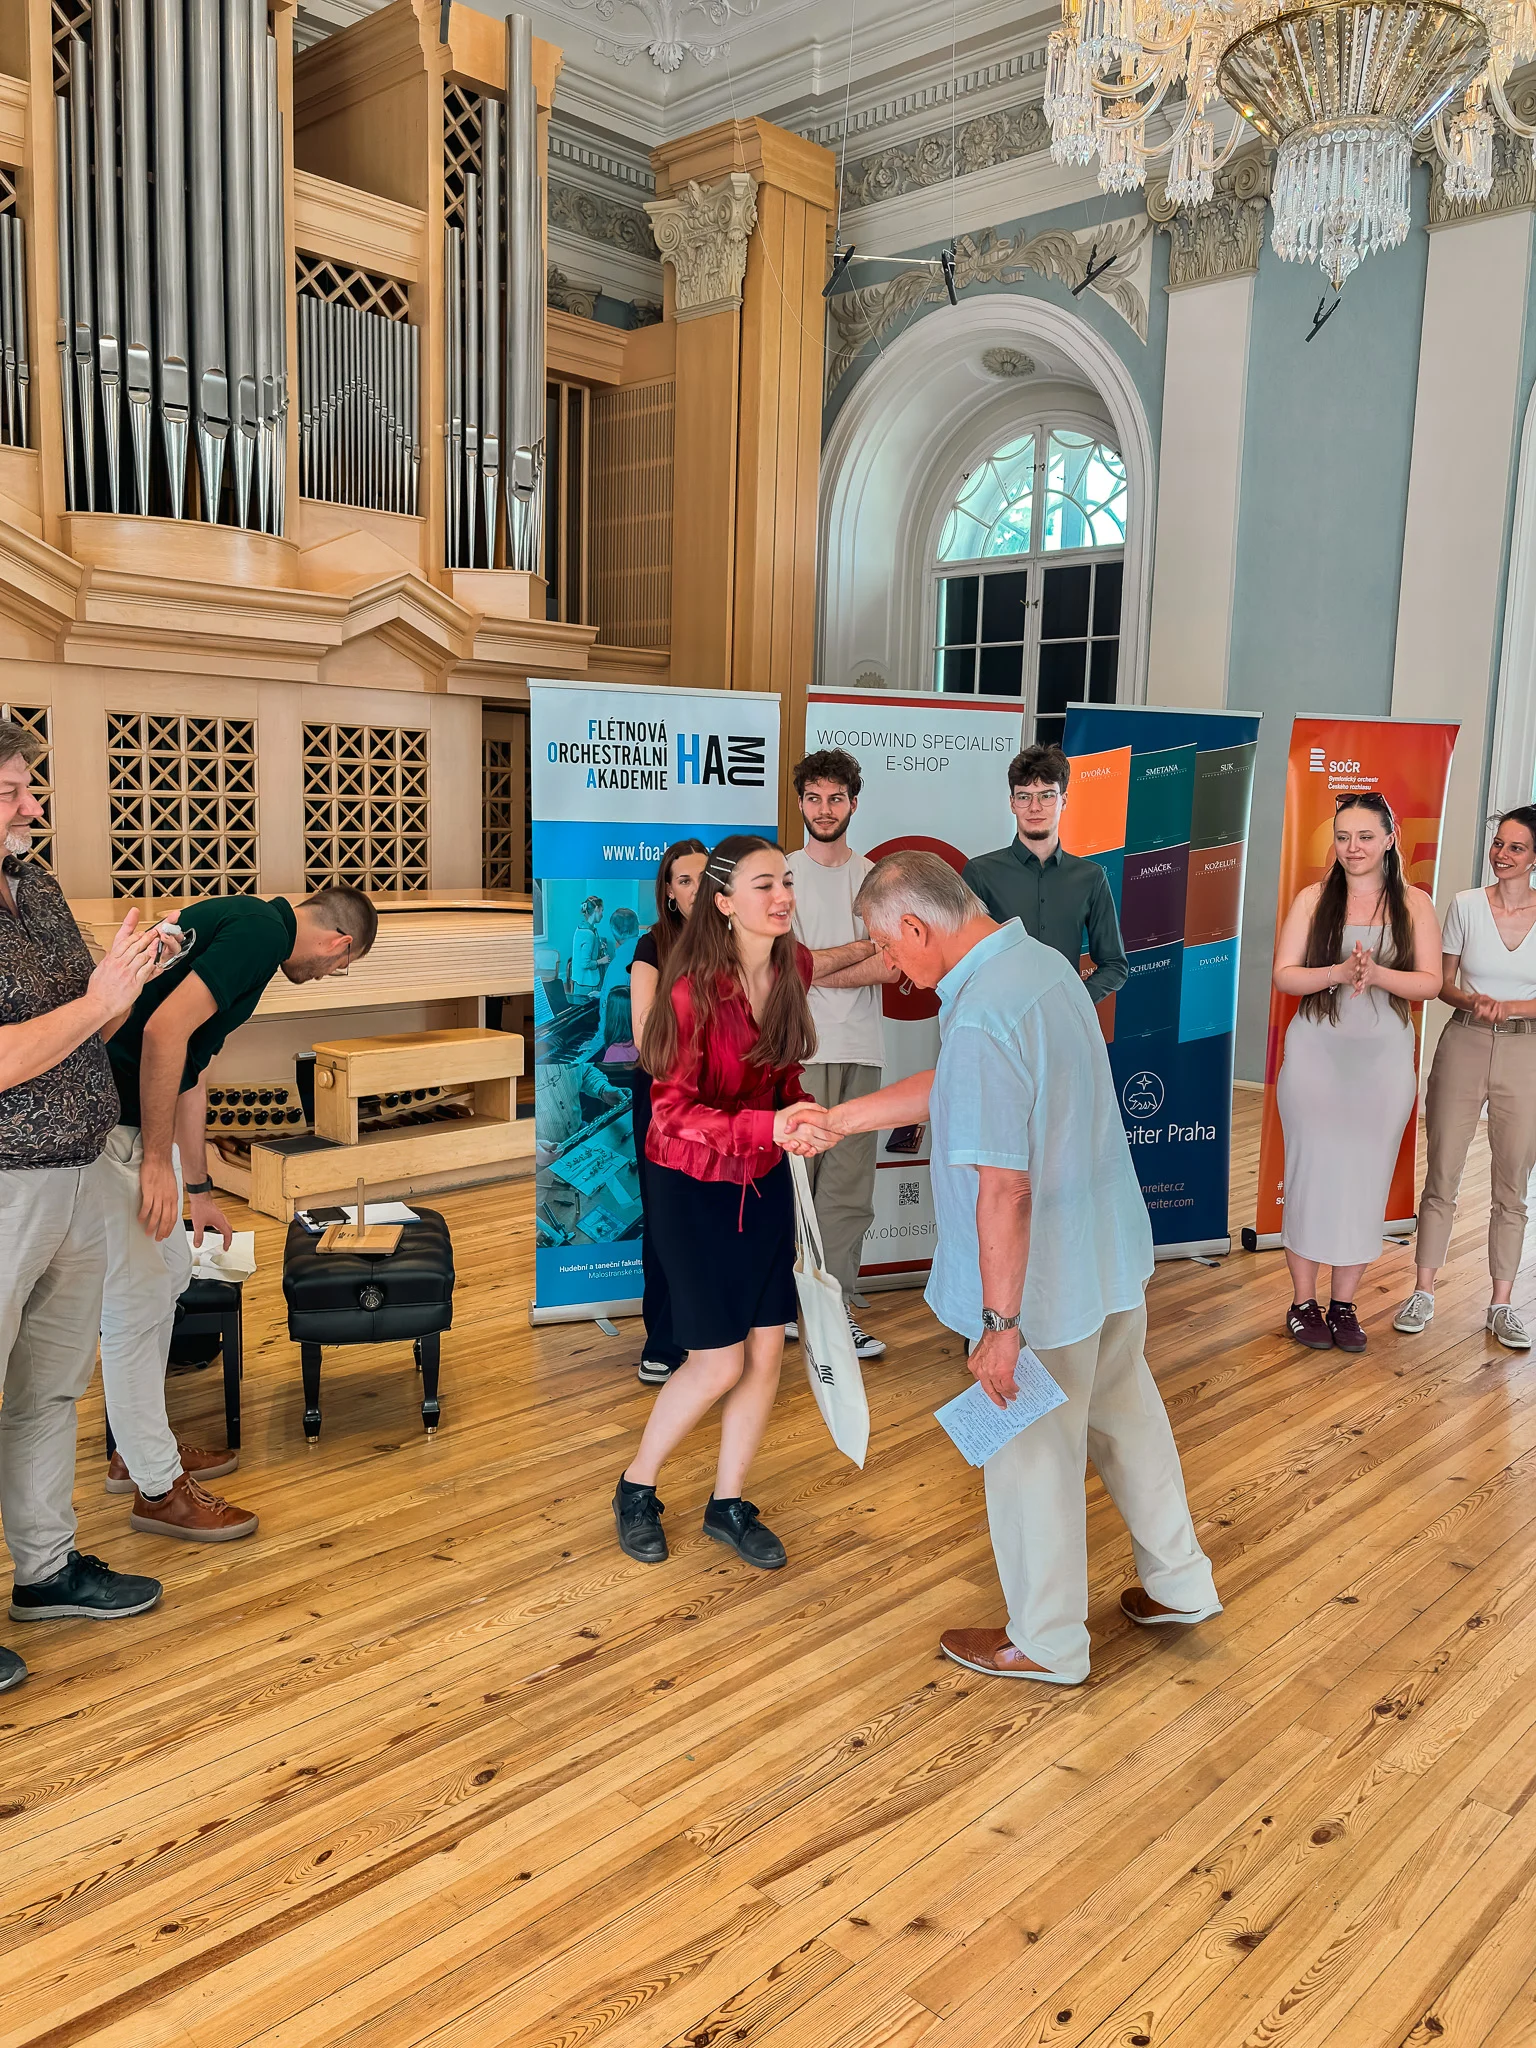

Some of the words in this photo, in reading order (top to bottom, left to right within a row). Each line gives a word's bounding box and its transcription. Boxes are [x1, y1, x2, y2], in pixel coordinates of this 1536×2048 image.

[588, 717, 667, 743] FLÉTNOVÁ
[817, 730, 917, 749] WOODWIND
[922, 734, 1014, 752] SPECIALIST
[547, 741, 667, 767] ORCHESTRÁLNÍ
[886, 755, 950, 771] E-SHOP
[1145, 764, 1179, 776] SMETANA
[1220, 762, 1234, 772] SUK
[1329, 759, 1361, 773] SOČR
[586, 768, 668, 790] AKADEMIE
[1080, 766, 1112, 779] DVOŘÁK
[1140, 862, 1172, 876] JANÁČEK
[1204, 858, 1237, 871] KOŽELUH
[1130, 958, 1172, 974] SCHULHOFF
[1199, 954, 1229, 966] DVOŘÁK
[1168, 1121, 1216, 1143] Praha
[559, 1264, 588, 1273] Hudební
[595, 1260, 620, 1270] taneční
[588, 1268, 633, 1279] Malostranské
